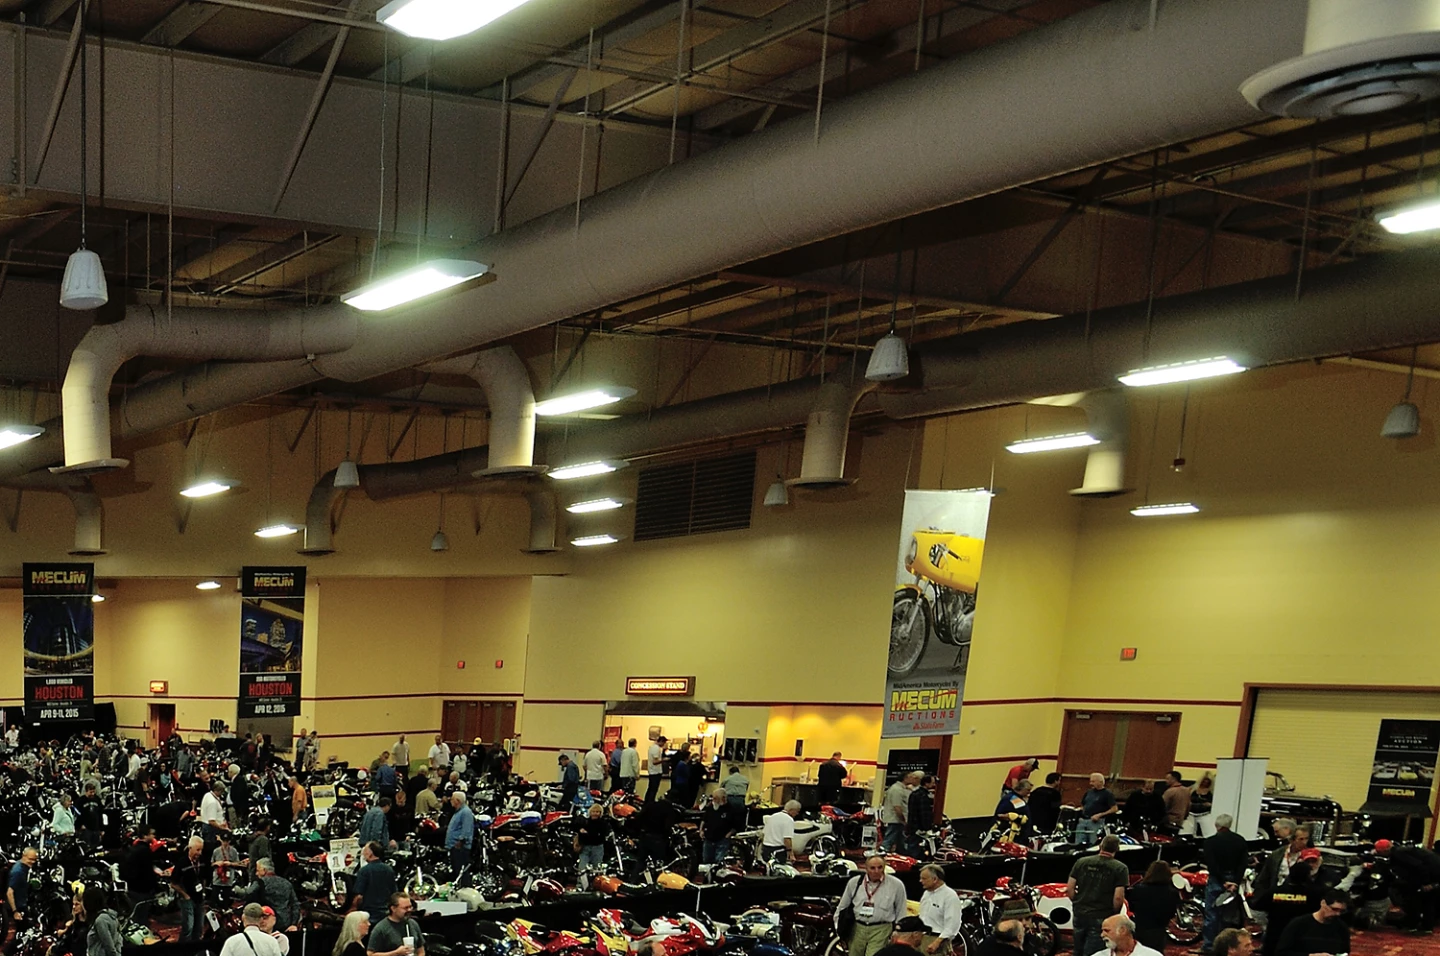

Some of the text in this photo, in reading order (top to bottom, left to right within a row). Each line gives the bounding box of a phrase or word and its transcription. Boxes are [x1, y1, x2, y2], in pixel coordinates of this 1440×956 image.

[32, 571, 86, 584] MECUM
[254, 576, 294, 587] MECUM
[35, 685, 83, 700] HOUSTON
[248, 682, 293, 696] HOUSTON
[890, 689, 958, 711] MECUM
[40, 709, 52, 718] APR
[65, 708, 79, 718] 2015
[254, 704, 265, 714] APR
[889, 710, 955, 721] AUCTIONS
[1382, 788, 1415, 797] MECUM
[1273, 893, 1307, 902] MECUM
